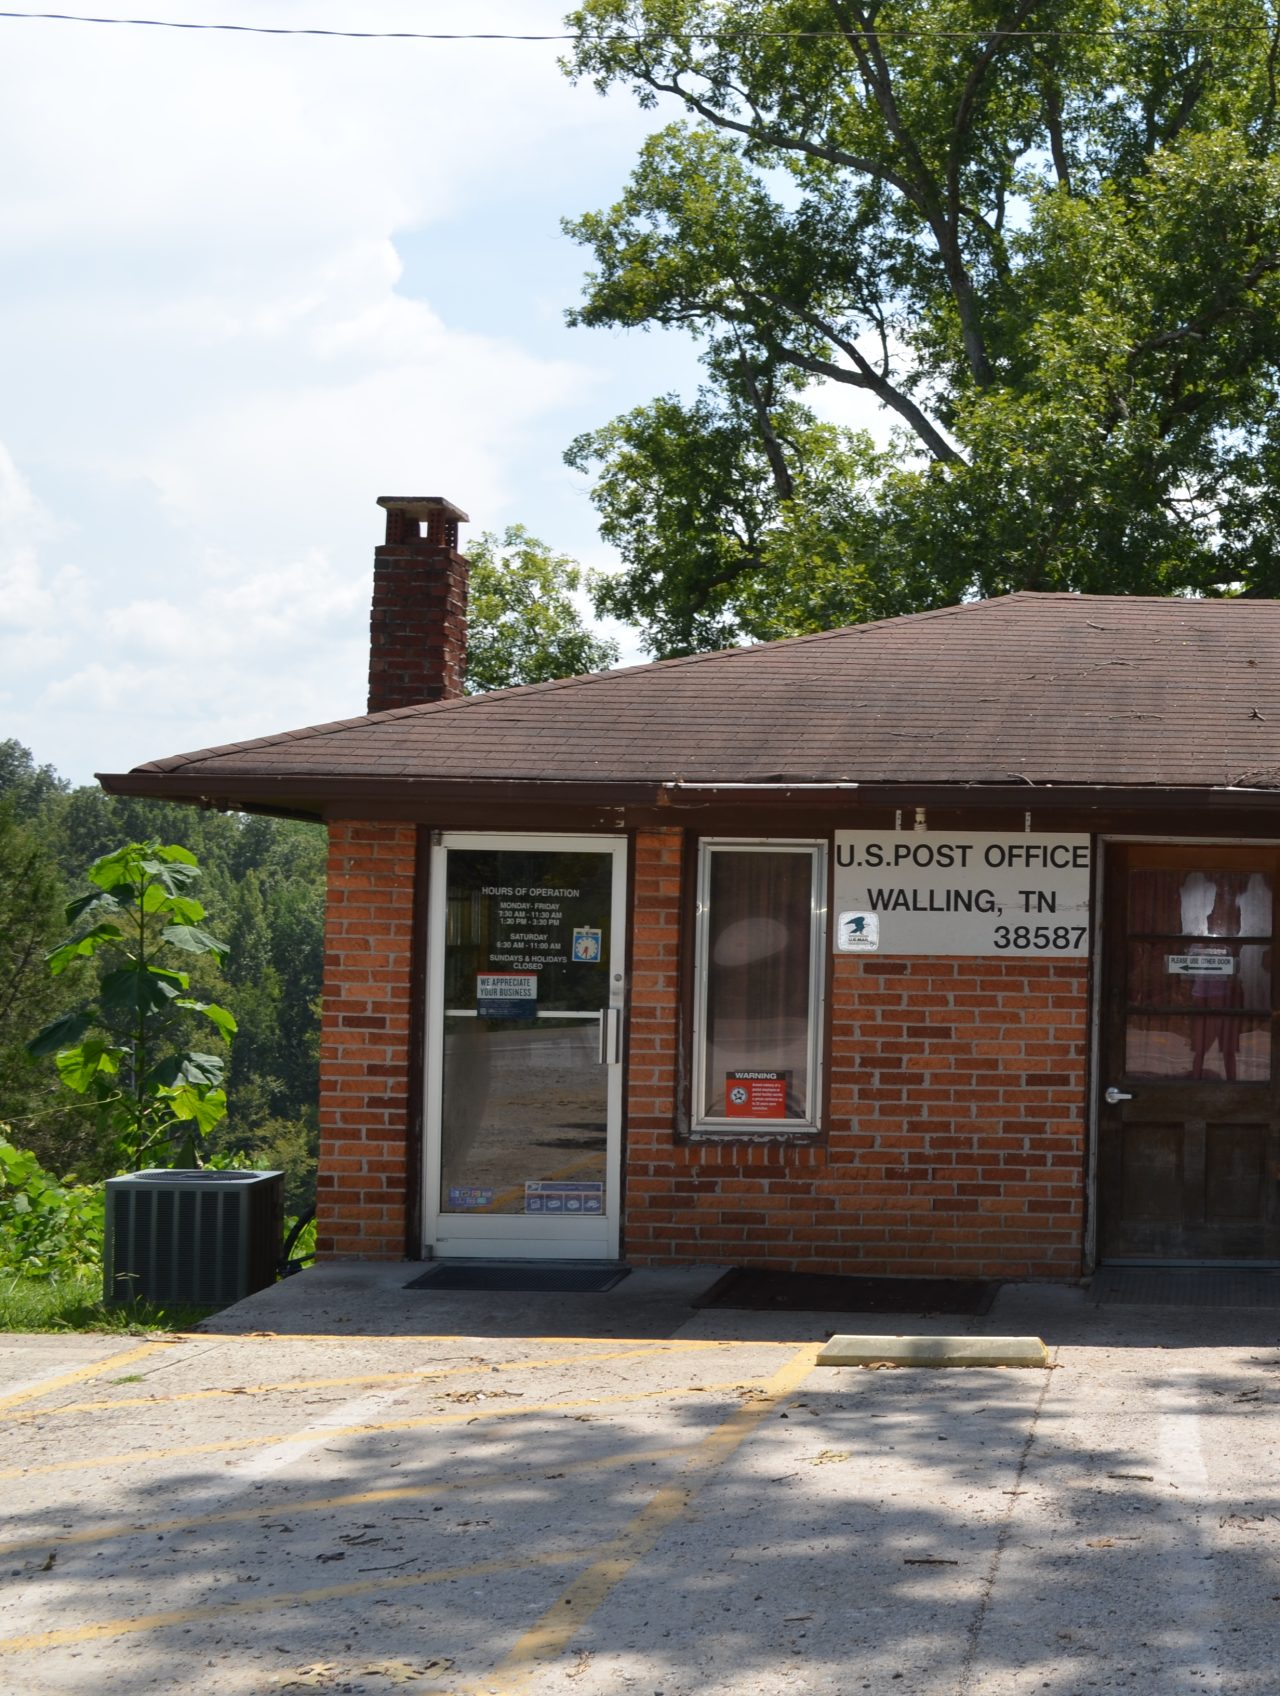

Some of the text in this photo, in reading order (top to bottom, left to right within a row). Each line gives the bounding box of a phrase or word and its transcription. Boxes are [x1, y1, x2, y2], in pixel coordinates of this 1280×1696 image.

[984, 844, 1089, 869] OFFICE
[482, 886, 580, 898] HOURS OF OPERATION
[867, 888, 1056, 918] WALLING, TN
[510, 933, 548, 941] SATURDAY
[993, 926, 1088, 950] 38587
[489, 954, 523, 962] SUNDAYS
[532, 955, 567, 963] HOLIDAYS
[480, 978, 531, 987] WE APPRECIATE
[480, 988, 532, 997] YOUR BUSINESS
